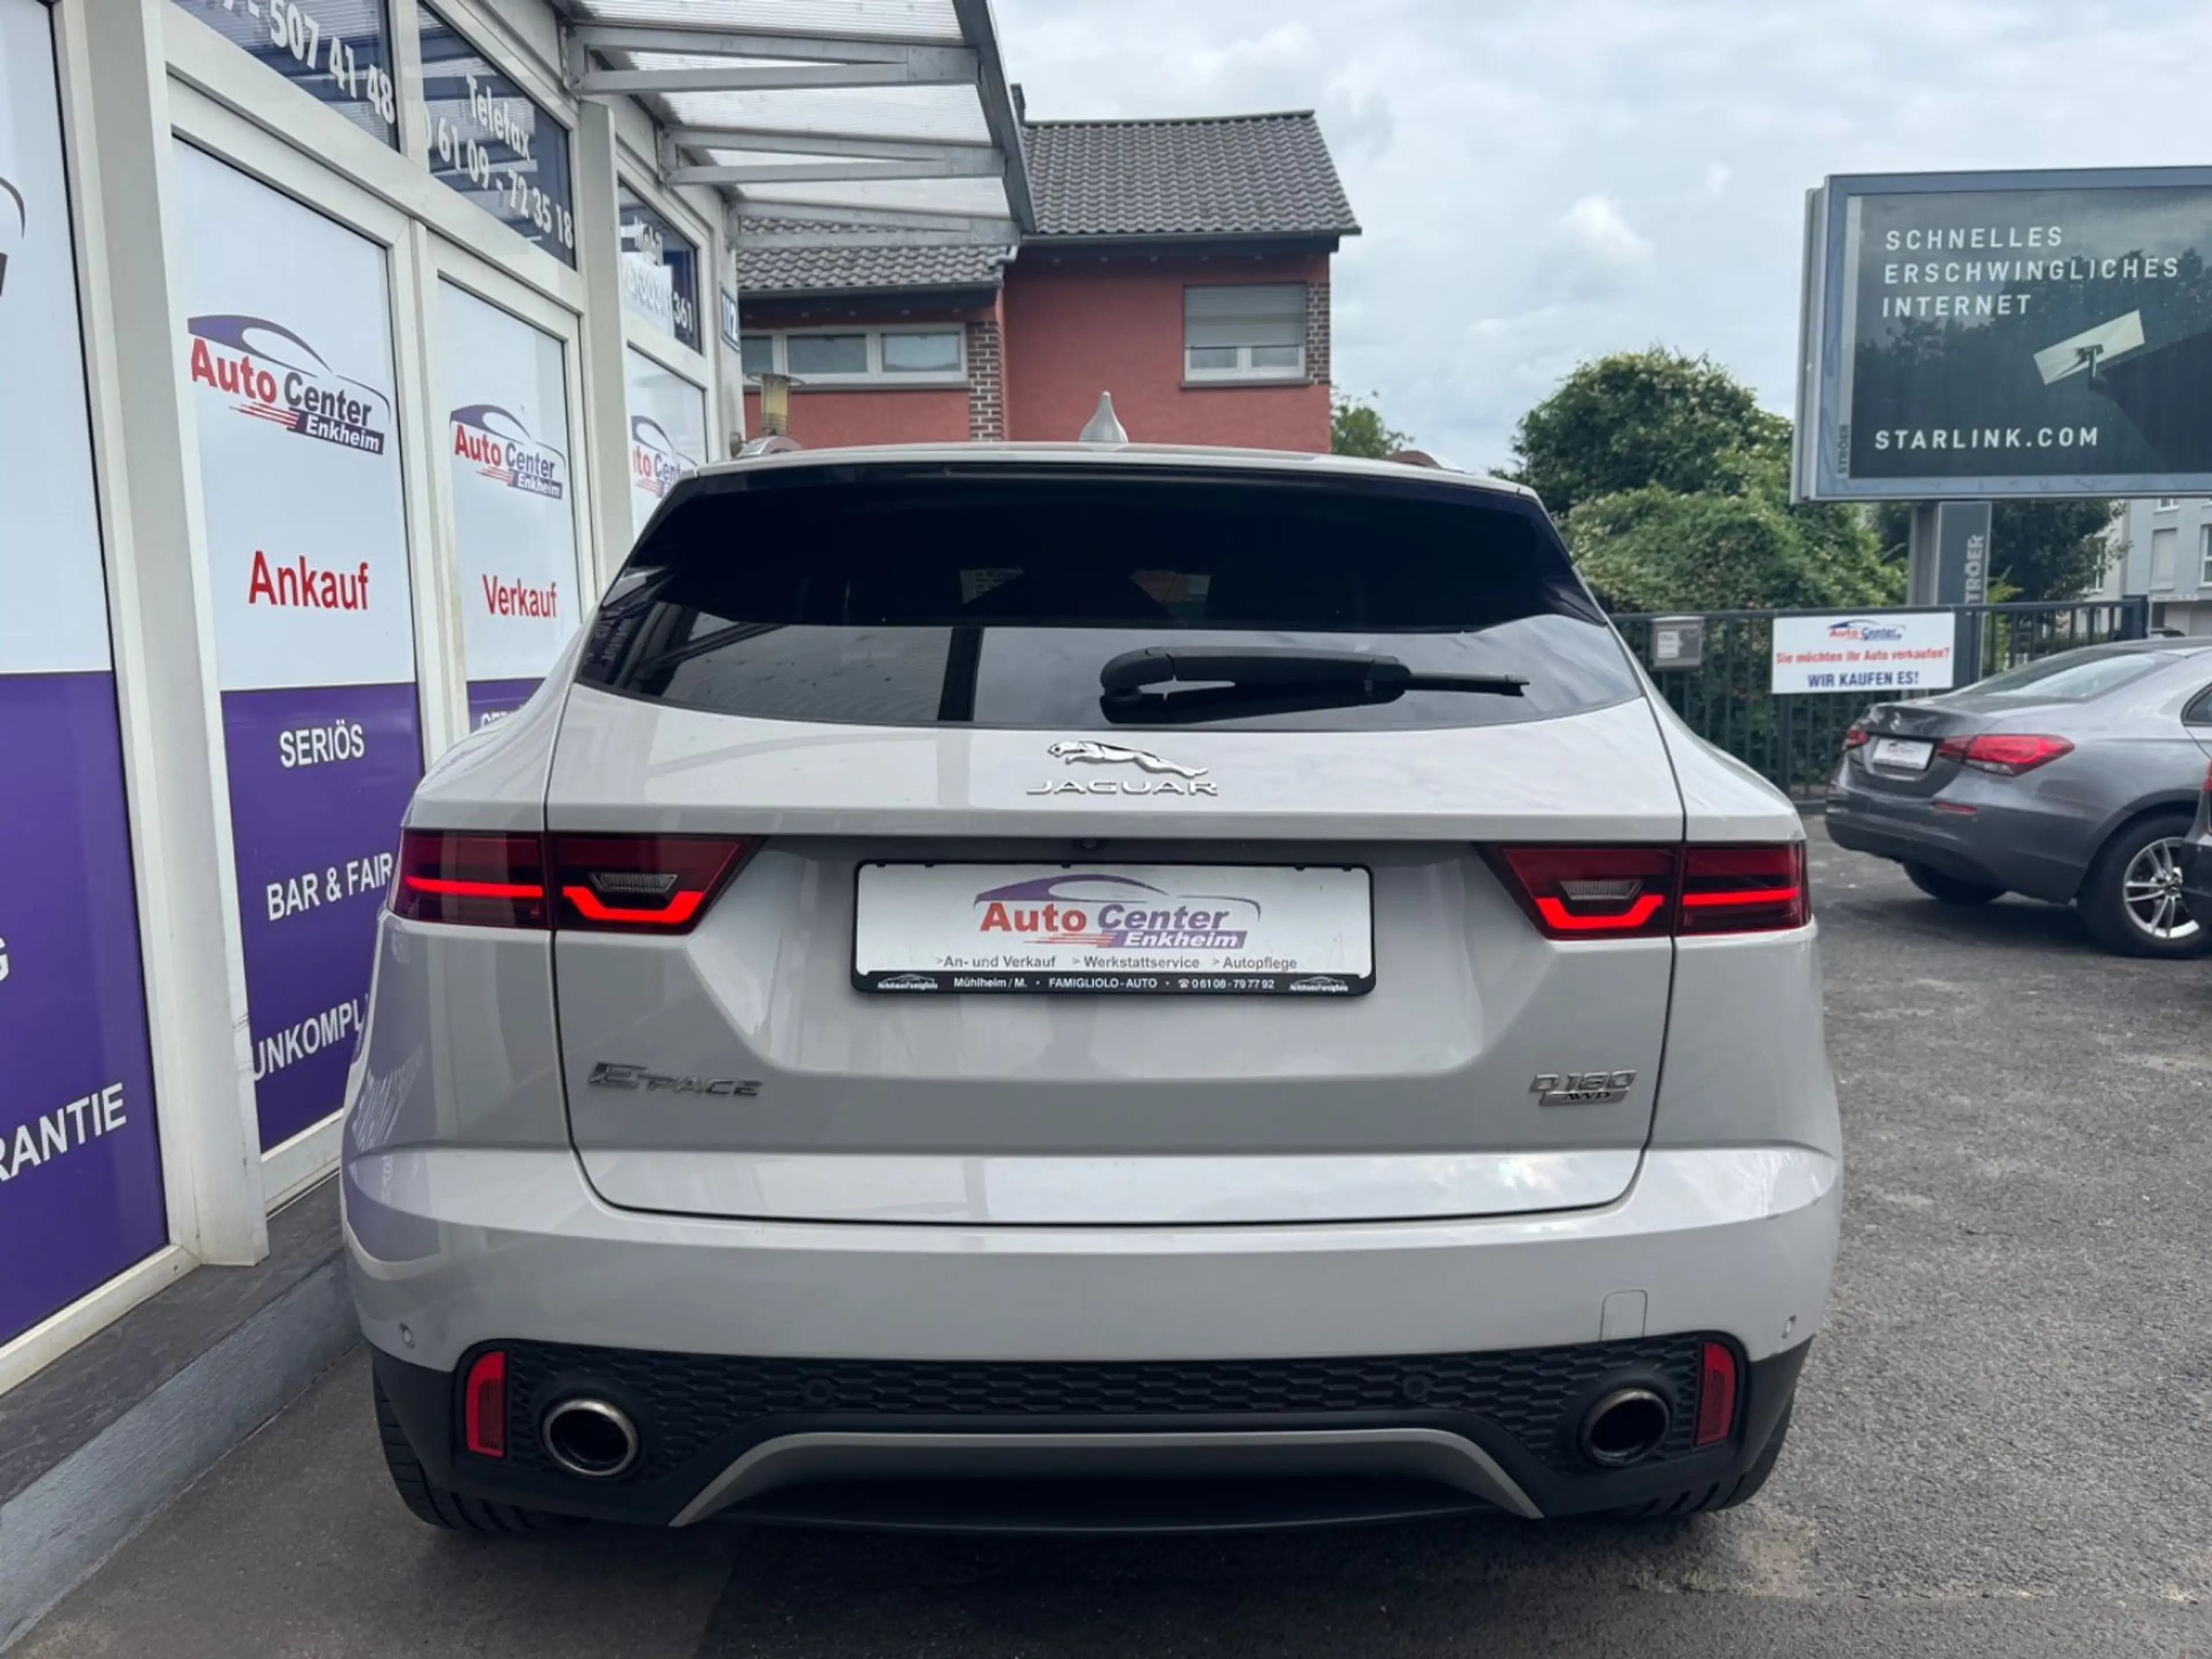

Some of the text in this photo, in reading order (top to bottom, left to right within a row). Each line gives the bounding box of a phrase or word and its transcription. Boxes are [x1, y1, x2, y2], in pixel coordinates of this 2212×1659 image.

[329, 36, 357, 99] 41
[367, 64, 395, 124] 48
[465, 72, 531, 162] Telefax
[438, 117, 461, 172] 61
[467, 138, 489, 190] 09
[507, 167, 529, 219] 72
[532, 187, 552, 233] 35
[555, 203, 573, 249] 18
[1885, 226, 2063, 251] SCHNELLES
[1884, 257, 2179, 285] ERSCHWINGLICHES
[1882, 294, 2032, 318] INTERNET
[191, 338, 373, 427] Auto Center
[305, 416, 381, 453] Enkheim
[1874, 426, 2099, 450] STARLINK.COM
[454, 424, 555, 479] Auto Center
[517, 474, 562, 498] Enkheim
[248, 550, 369, 609] Ankauf
[482, 574, 558, 618] Verkauf
[1808, 671, 1919, 687] WIR KAUFEN ES!
[280, 719, 365, 768] SERIÖS
[1025, 779, 1218, 796] JAGUAR
[266, 852, 392, 921] BAR & FAIR
[980, 903, 1229, 932] Auto Center
[1124, 931, 1237, 948] Enkheim
[972, 956, 1001, 968] und
[1003, 956, 1056, 968] Verkauf
[1084, 956, 1200, 969] Werkstattservice
[1222, 956, 1297, 971] Autopflege
[953, 976, 1006, 988] Mühlheim
[254, 993, 369, 1081] UNKOMPL
